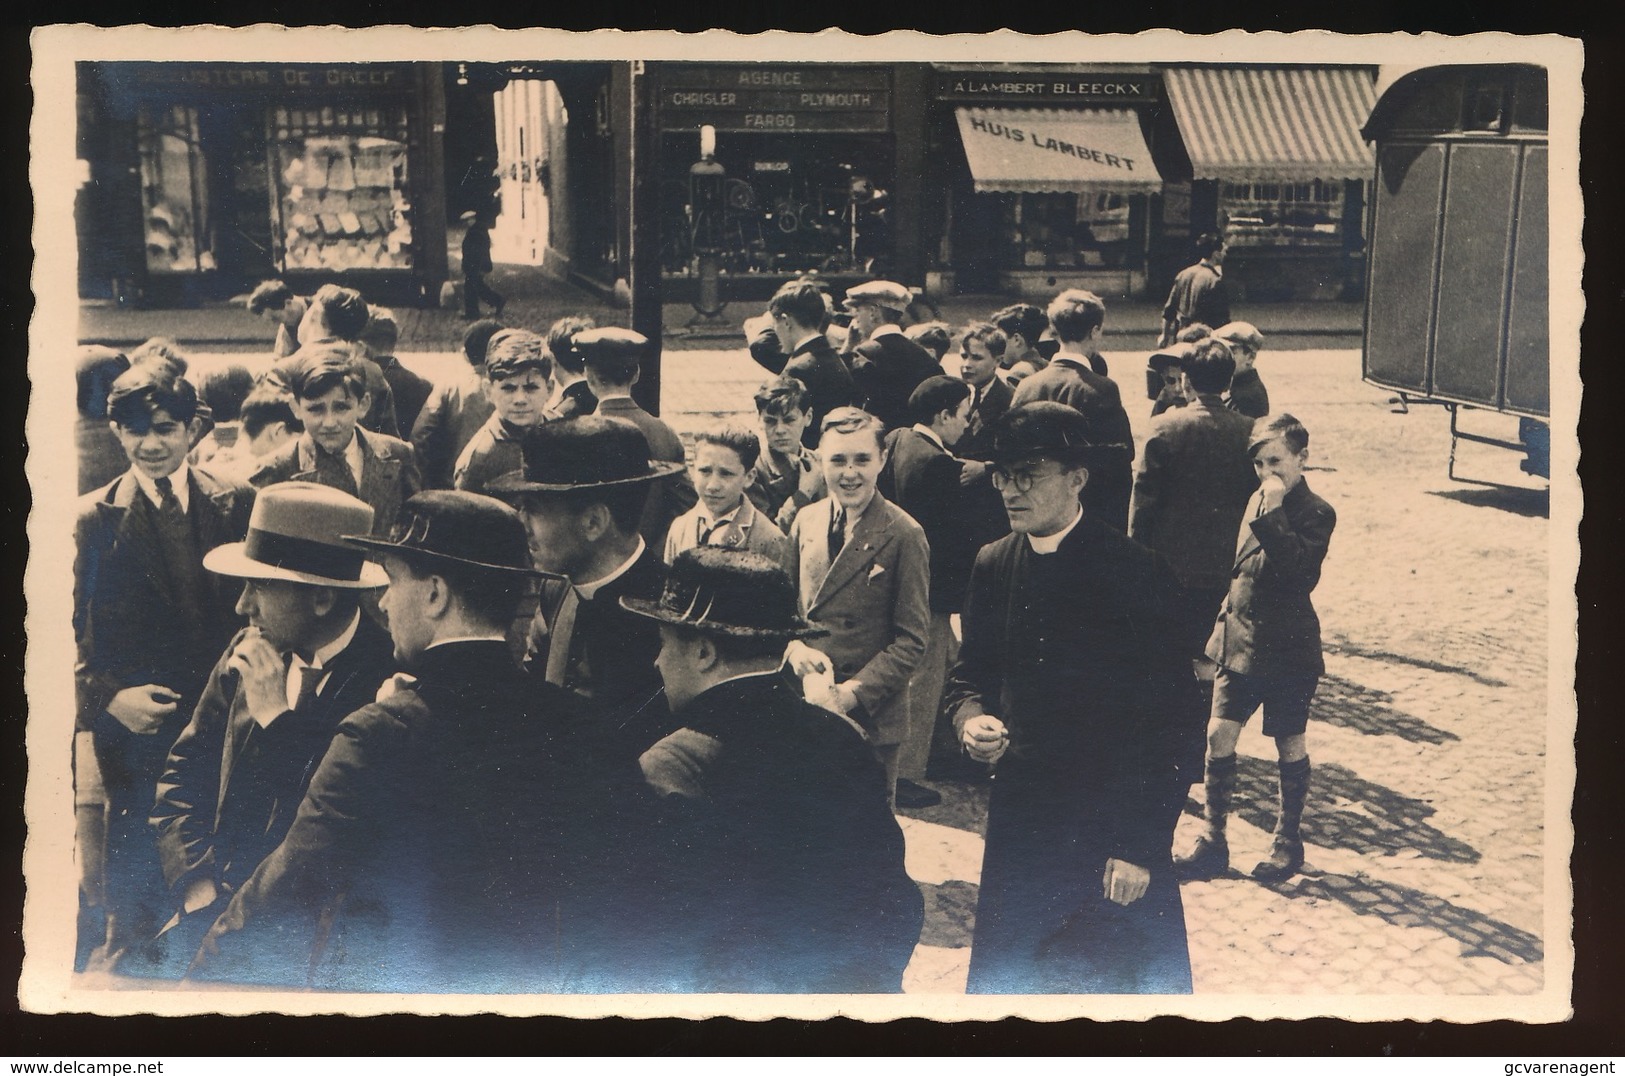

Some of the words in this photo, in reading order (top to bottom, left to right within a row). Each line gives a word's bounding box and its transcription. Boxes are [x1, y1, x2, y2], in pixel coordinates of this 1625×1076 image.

[738, 71, 802, 85] AGENCE
[1053, 83, 1141, 95] BLEECKX
[672, 92, 736, 105] CHRISLER
[801, 93, 871, 106] PLYMOUTH
[745, 114, 796, 127] FARGO
[970, 117, 1025, 142] HUIS
[1032, 133, 1135, 171] LAMBERT
